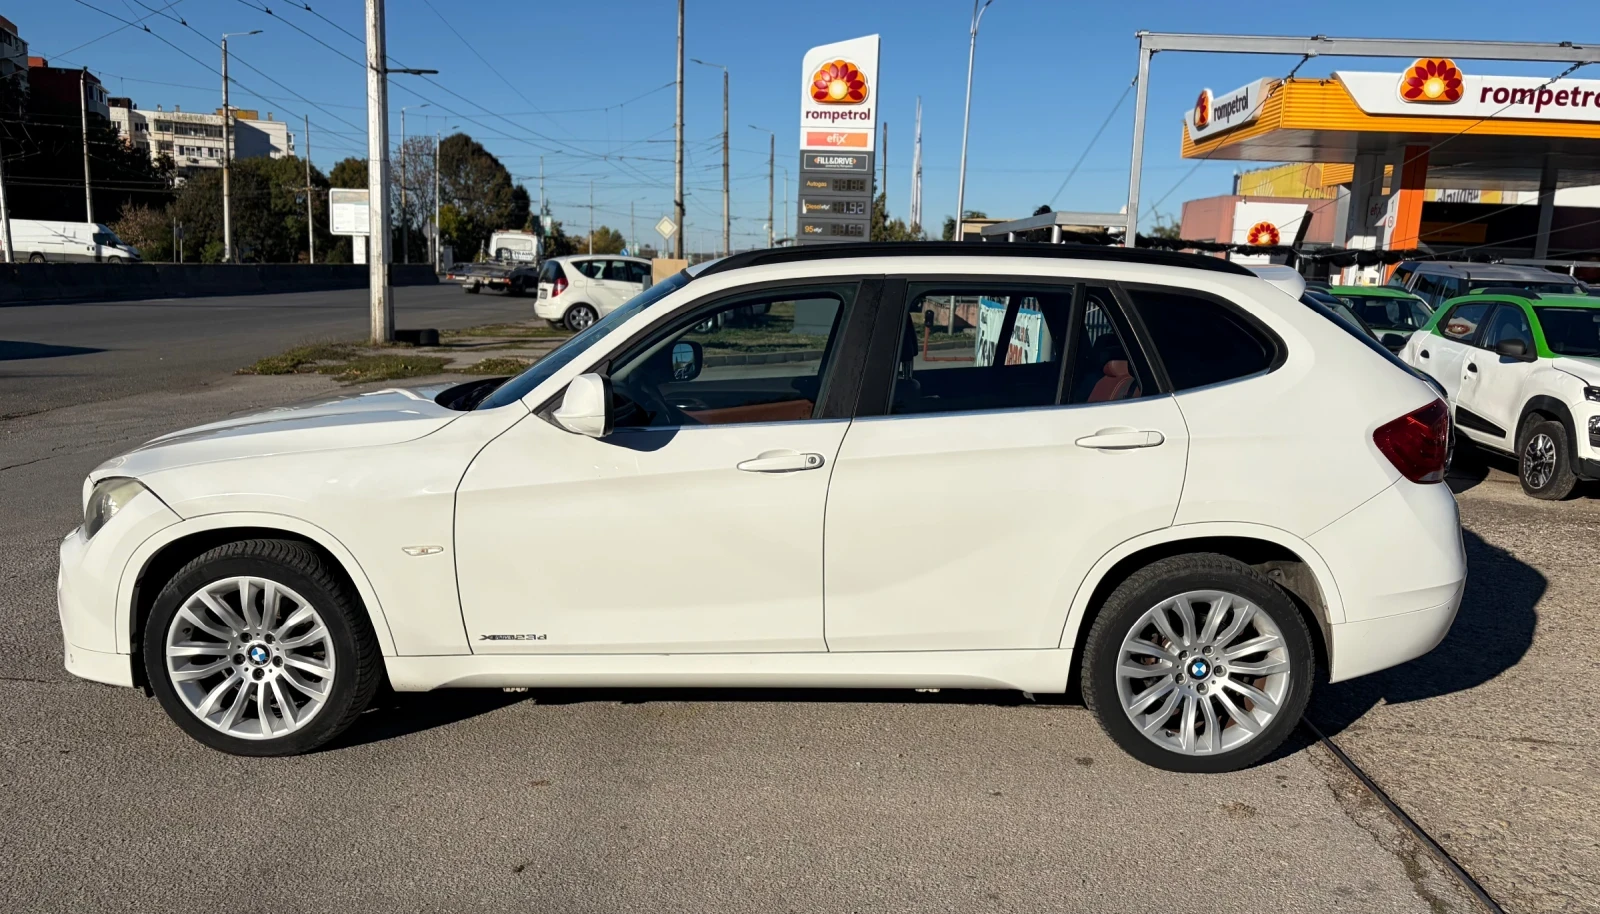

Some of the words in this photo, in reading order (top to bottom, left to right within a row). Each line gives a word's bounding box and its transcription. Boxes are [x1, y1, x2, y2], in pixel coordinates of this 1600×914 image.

[1214, 87, 1248, 123] rompetrol
[806, 108, 870, 123] rompetrol
[827, 134, 847, 145] efix
[817, 157, 853, 165] FILL&DRIVE
